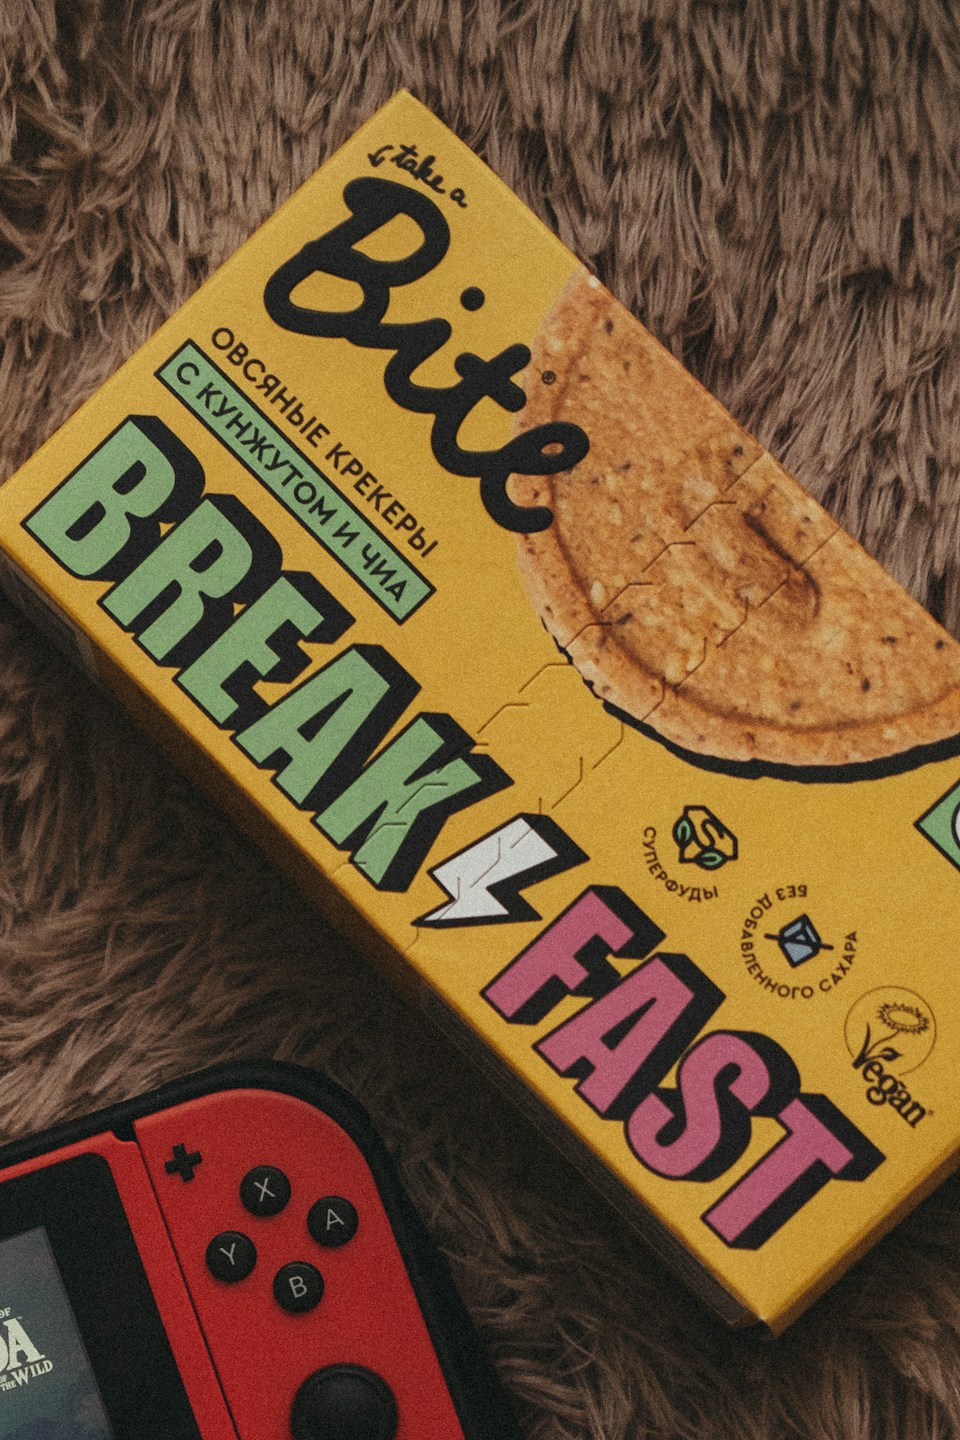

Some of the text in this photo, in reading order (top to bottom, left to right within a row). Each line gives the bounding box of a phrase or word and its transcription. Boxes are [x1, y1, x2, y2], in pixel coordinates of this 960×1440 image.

[390, 144, 467, 208] take a
[262, 176, 590, 534] Bite
[176, 362, 408, 602] С КУНЖУТОМ И ЧИА
[211, 327, 439, 558] ОВСЯНЫЕ КРЕКЕРЫ
[20, 414, 515, 892] BREAK
[643, 827, 718, 902] СУПЕРФУДЫ
[740, 884, 858, 999] БЕЗ ДОБАВЛЕННОГО САХАРА
[479, 885, 887, 1249] FAST
[851, 1022, 927, 1128] Vegan
[253, 1177, 276, 1203] X
[326, 1208, 345, 1231] A
[219, 1243, 237, 1266] Y
[288, 1276, 307, 1298] B
[1, 1381, 16, 1391] THE
[11, 1359, 53, 1386] WILD
